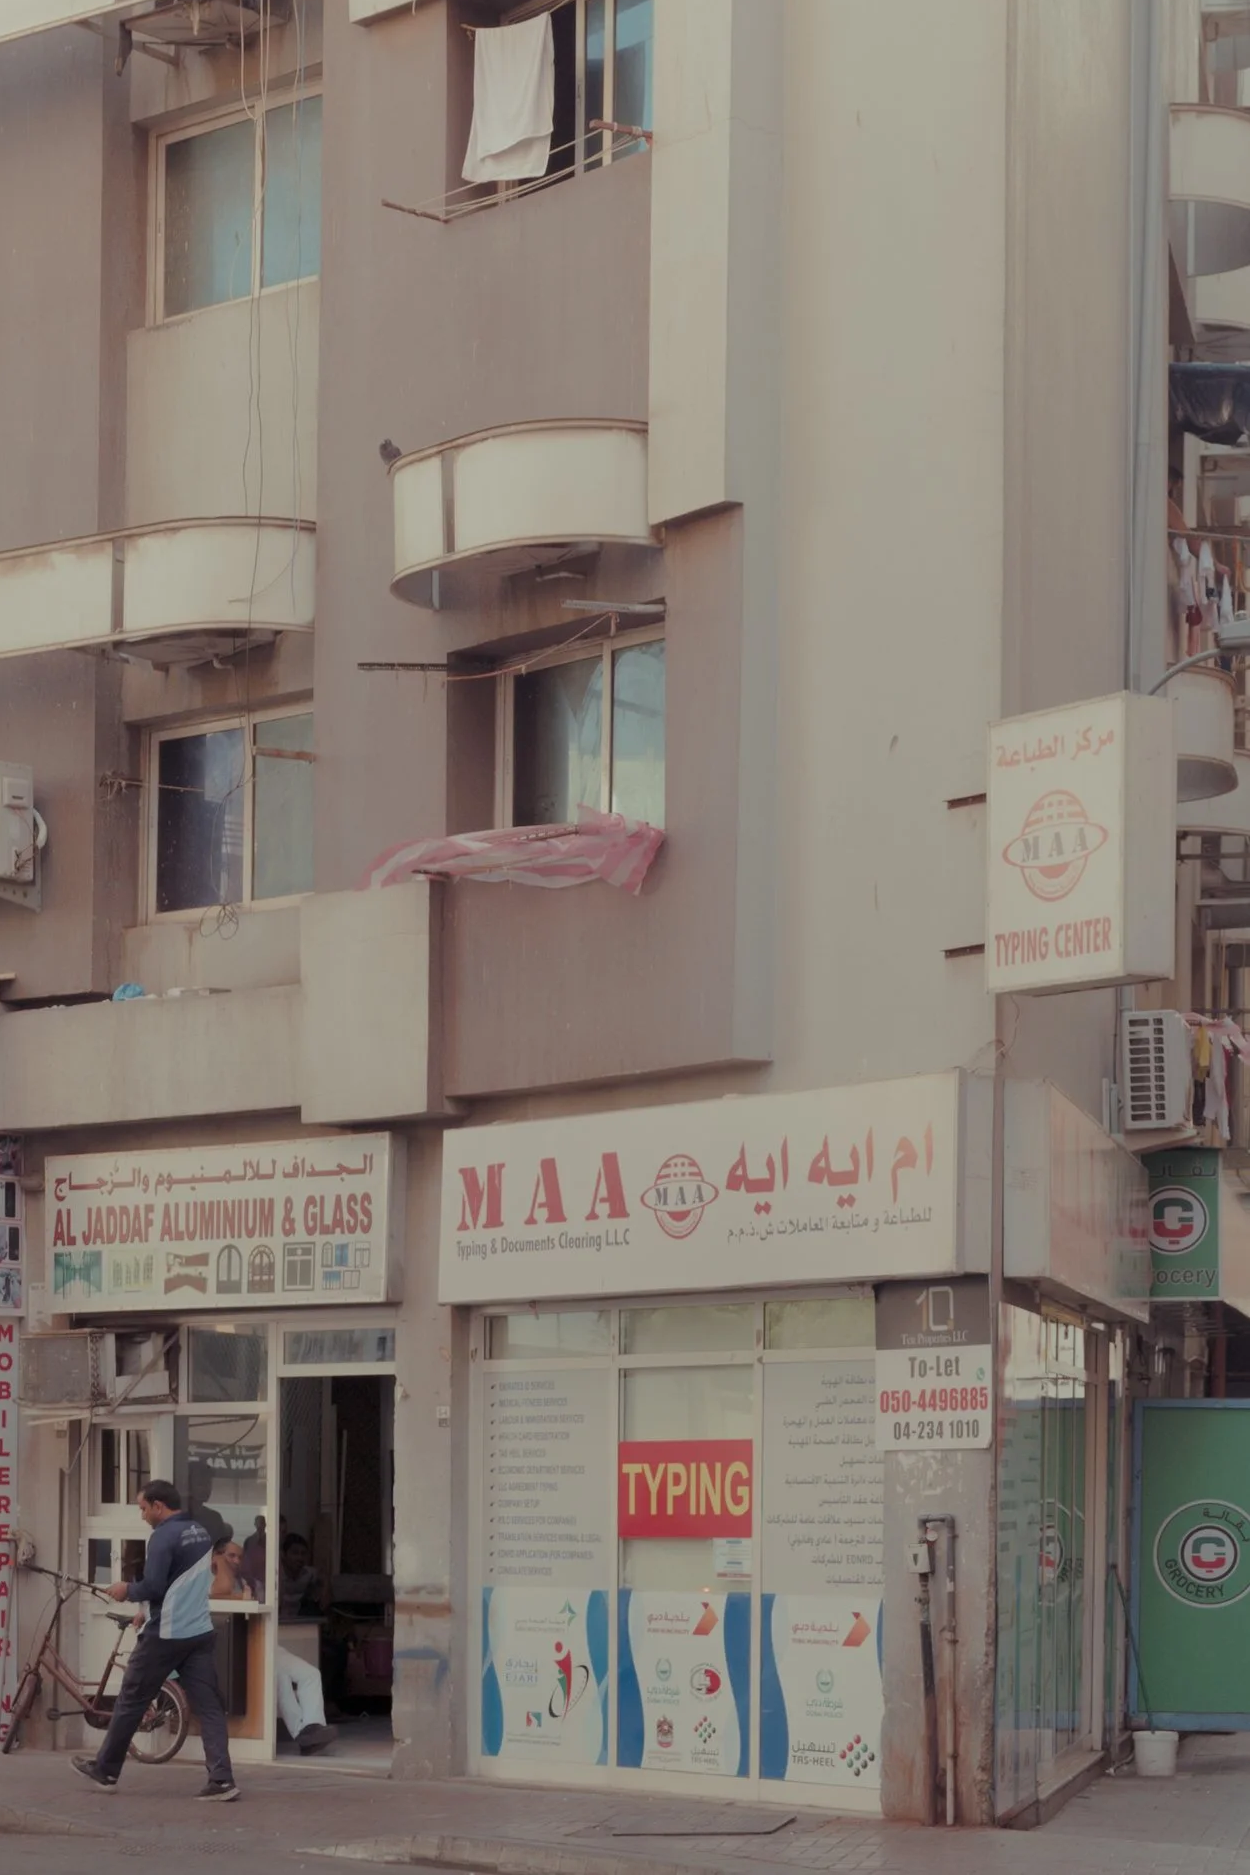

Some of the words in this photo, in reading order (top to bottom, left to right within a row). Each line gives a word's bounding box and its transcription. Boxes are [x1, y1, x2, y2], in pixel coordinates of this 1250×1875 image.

[996, 734, 1065, 773] الطباعة
[1071, 725, 1114, 760] مركز
[994, 926, 1049, 968] TYPING
[1054, 916, 1112, 960] CENTER
[281, 1153, 374, 1183] الجداف
[890, 1120, 934, 1205] ام
[53, 1208, 77, 1247] AL
[81, 1203, 155, 1245] JADDAF
[159, 1196, 275, 1242] ALUMINIUM
[281, 1195, 296, 1236] &
[303, 1191, 373, 1235] GLASS
[780, 1217, 830, 1234] المعاملات
[883, 1207, 933, 1231] للطباعة
[457, 1239, 487, 1261] Typing
[490, 1238, 497, 1255] &
[500, 1235, 555, 1253] Documents
[558, 1231, 602, 1253] Clearing
[605, 1228, 631, 1247] L.L.C
[952, 1330, 969, 1342] LLC
[908, 1355, 961, 1379] To-Let
[879, 1386, 989, 1414] 050-4496885
[893, 1420, 944, 1441] 04-234
[949, 1419, 980, 1439] 1010
[621, 1460, 750, 1516] TYPING
[1164, 1558, 1225, 1599] GROCERY
[506, 1674, 538, 1683] EJARI
[791, 1739, 837, 1754] تسهيل
